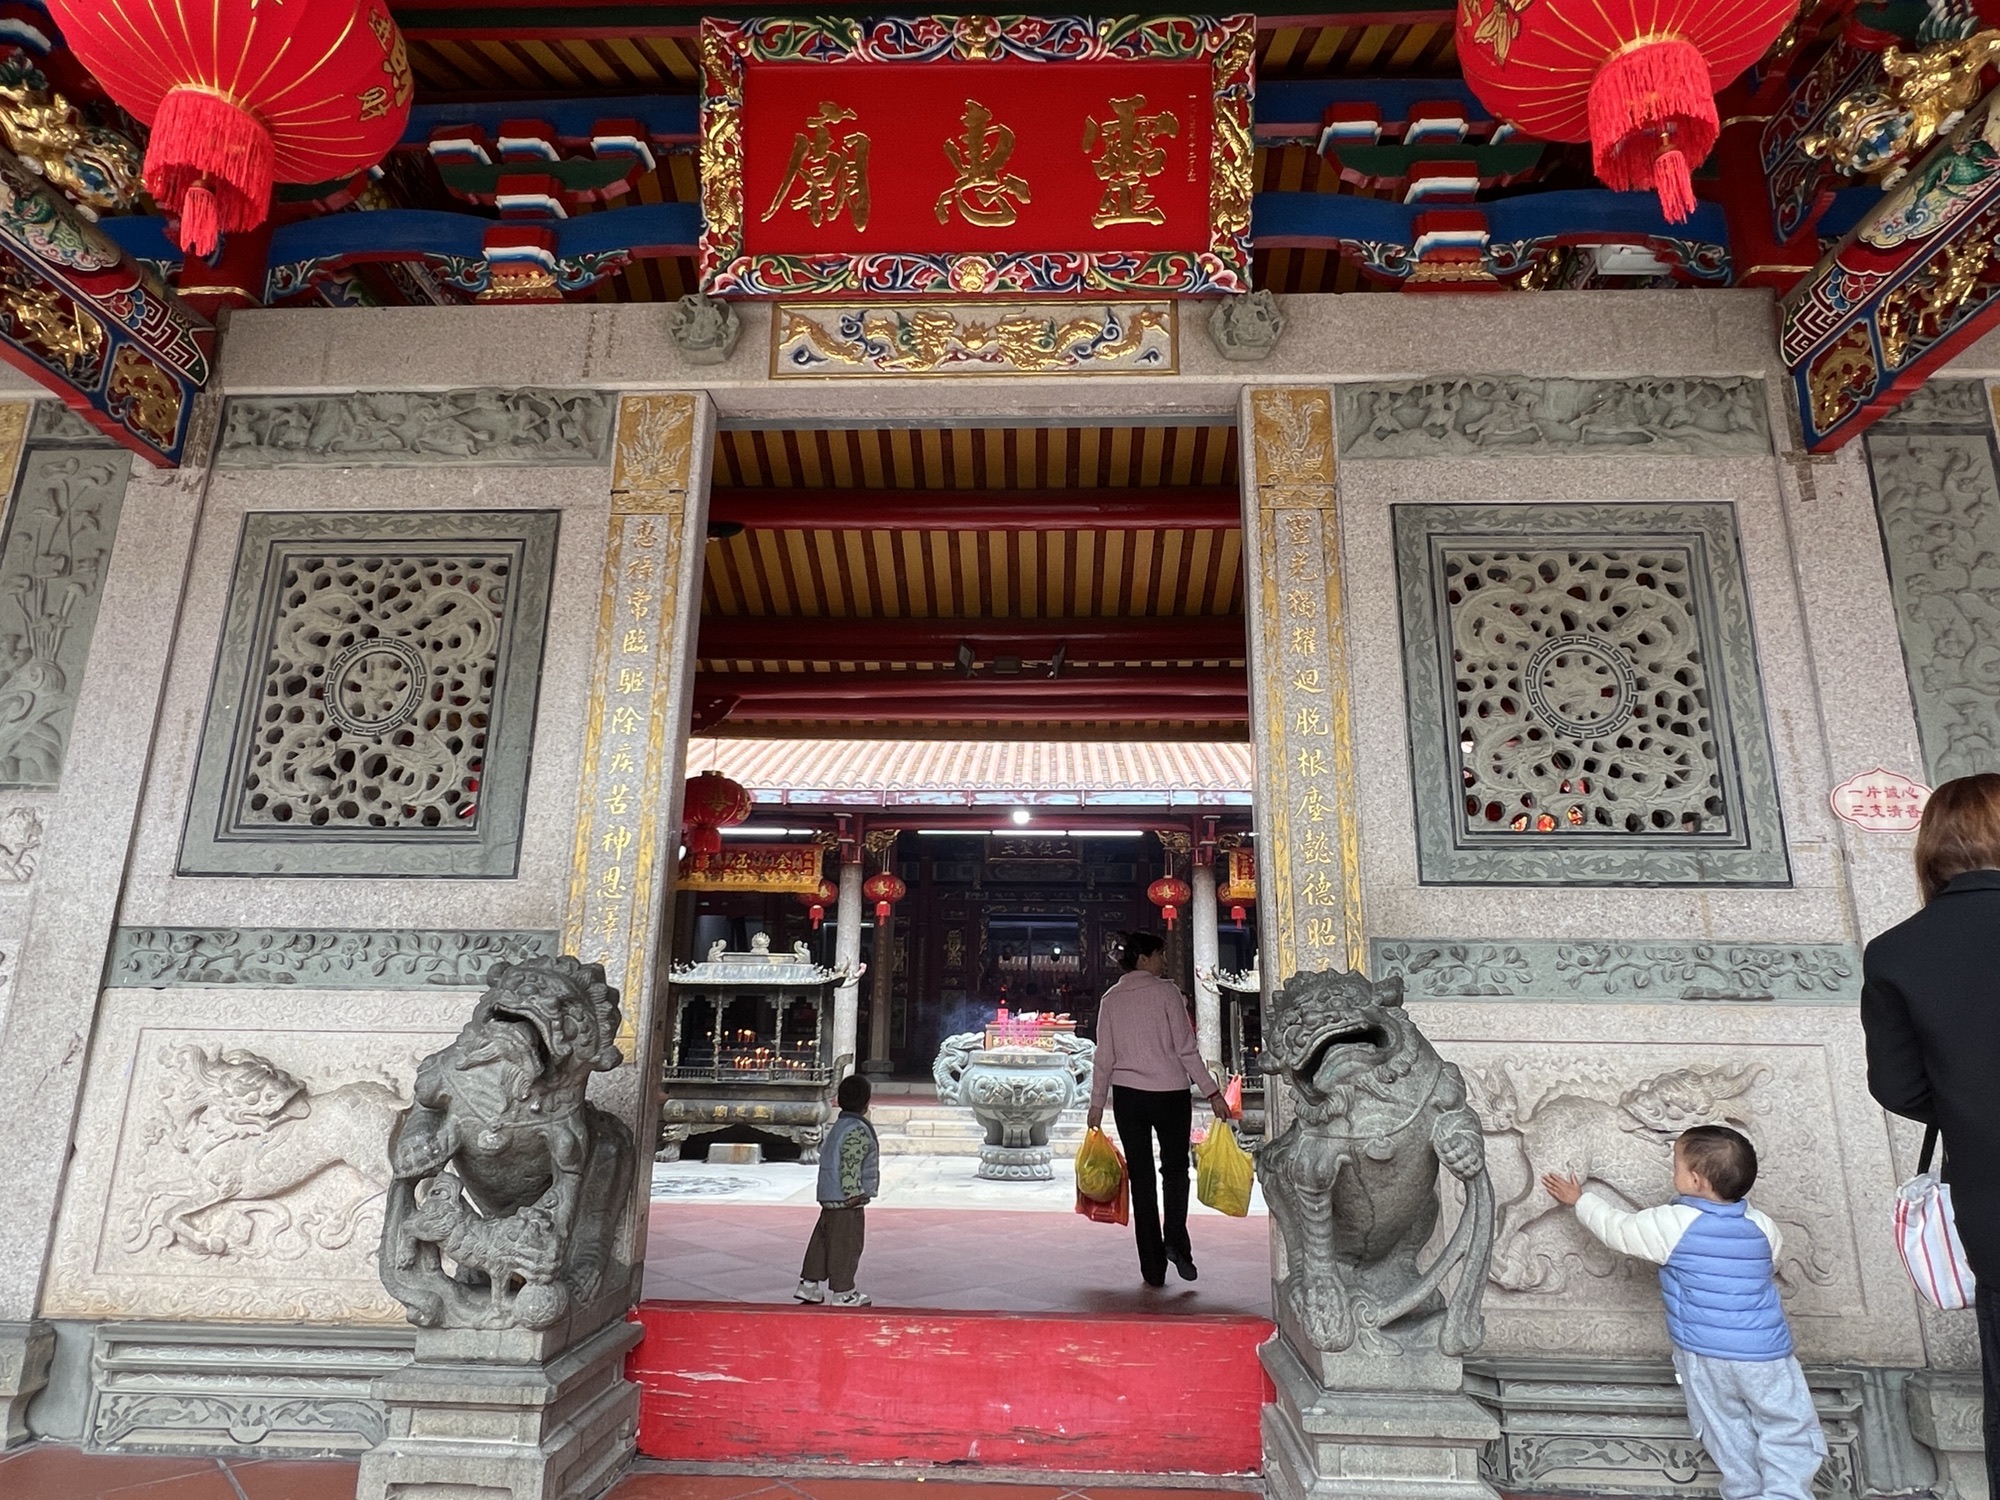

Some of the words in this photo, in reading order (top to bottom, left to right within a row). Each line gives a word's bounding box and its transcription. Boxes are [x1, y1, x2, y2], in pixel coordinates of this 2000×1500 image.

[761, 94, 1180, 232] 靈惠廟
[1851, 804, 1923, 818] 三支清香
